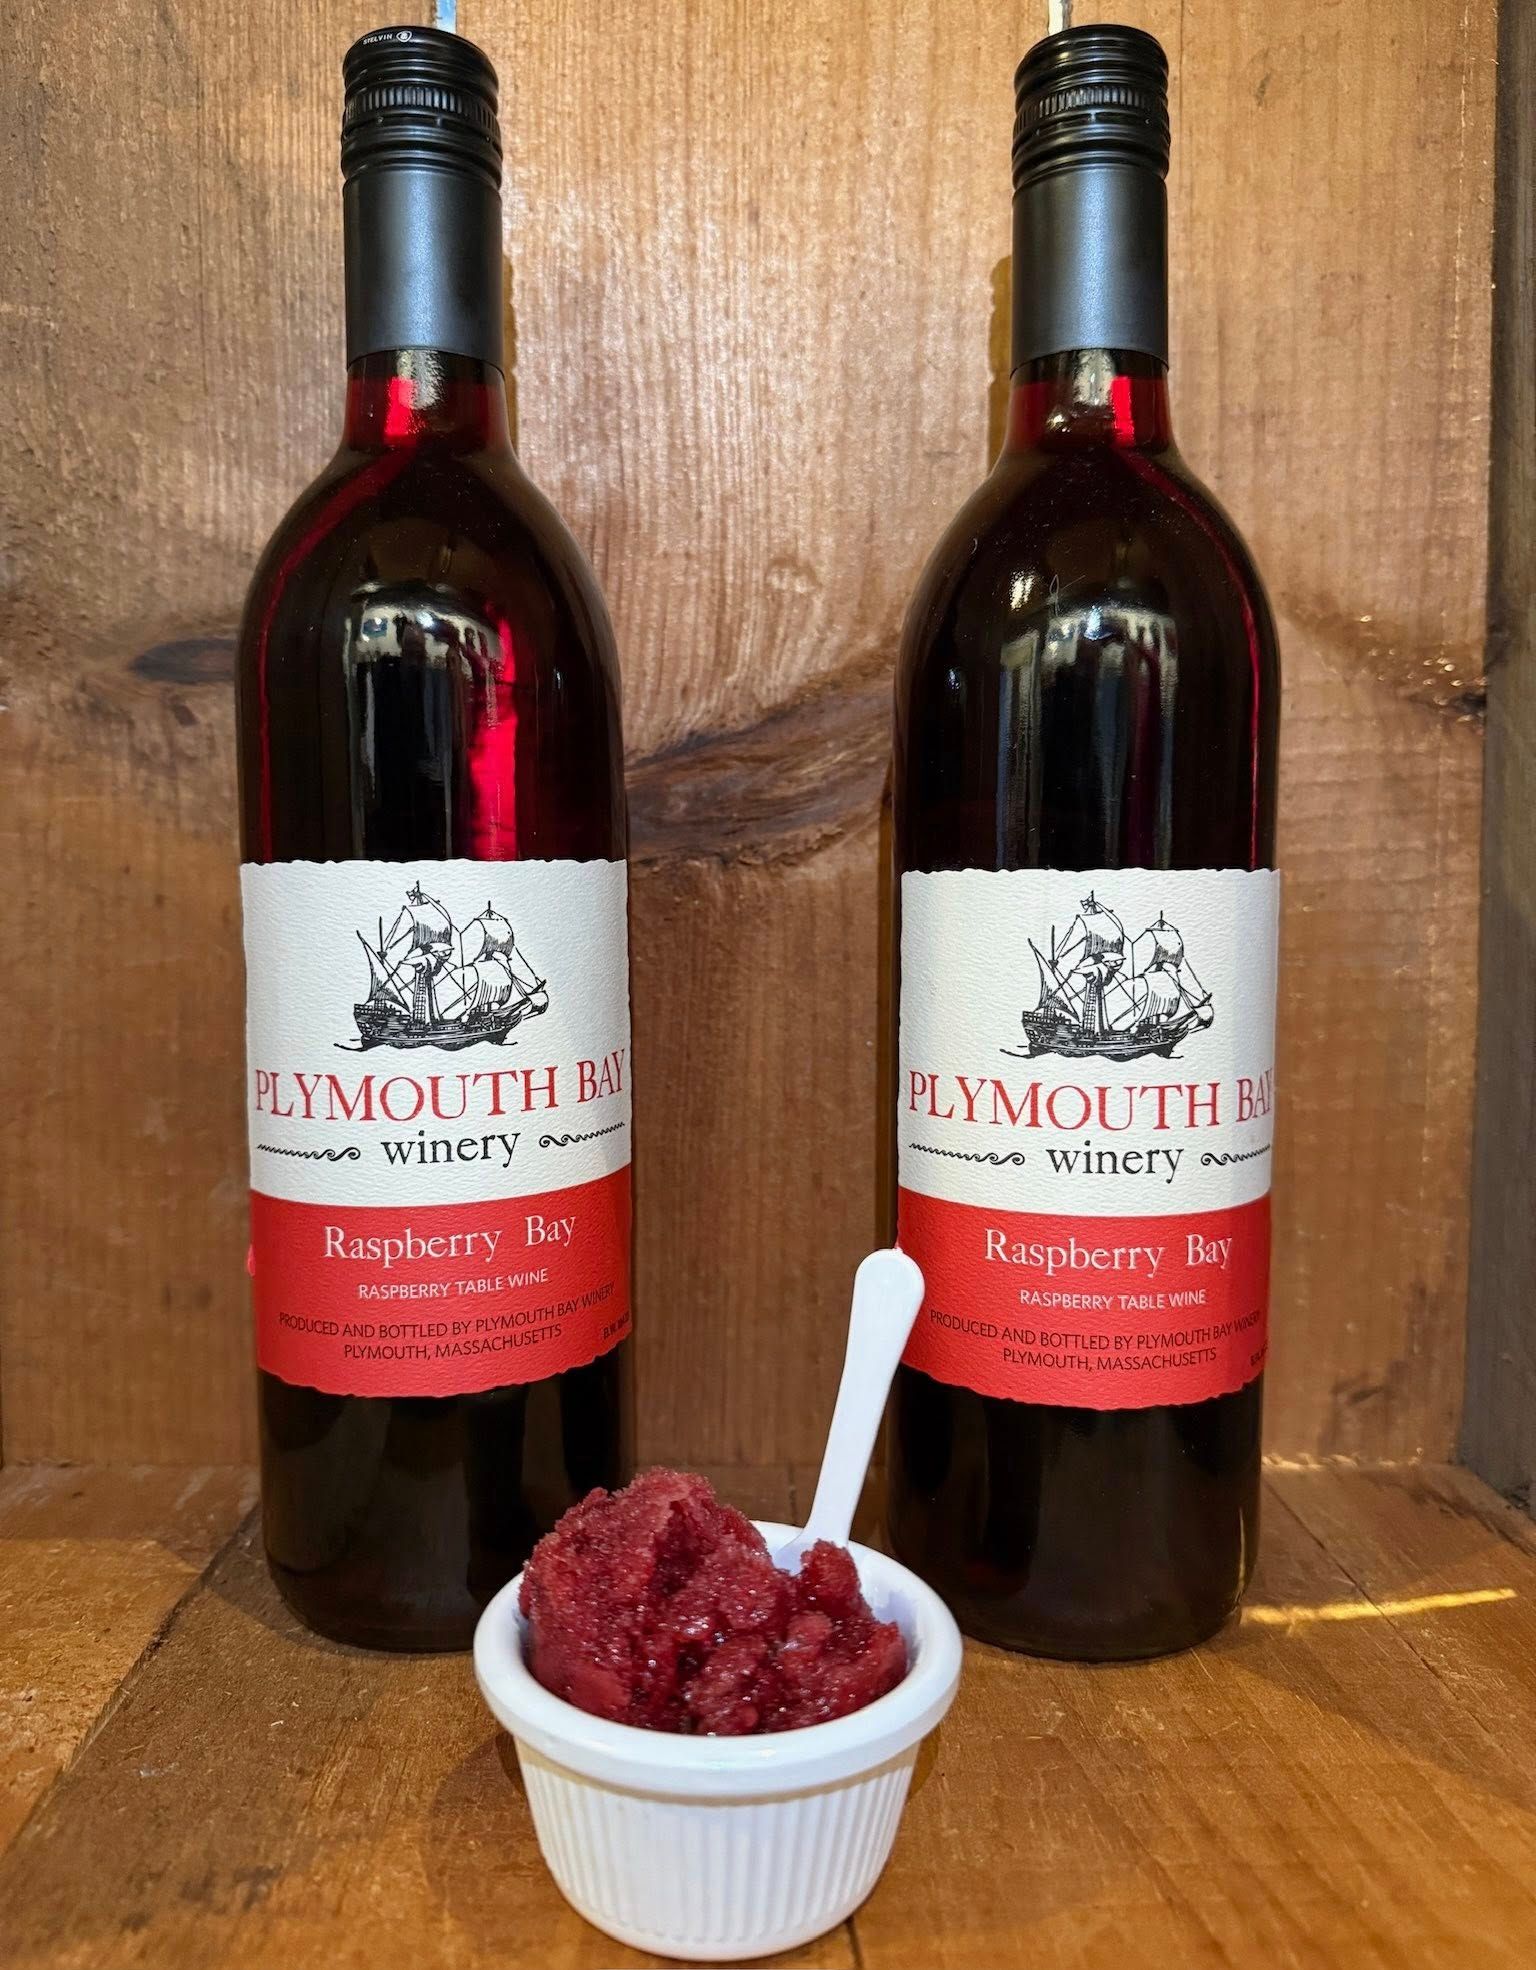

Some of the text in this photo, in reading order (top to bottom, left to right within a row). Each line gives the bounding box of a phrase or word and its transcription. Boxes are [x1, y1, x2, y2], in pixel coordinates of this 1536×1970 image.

[362, 33, 393, 45] STELVIN
[255, 1049, 625, 1121] PLYMOUTH BAY
[909, 1068, 1273, 1131] PLYMOUTH BAY
[381, 1130, 521, 1168] winery
[1046, 1140, 1184, 1184] winery
[323, 1214, 577, 1269] Raspberry Bay
[984, 1229, 1233, 1278] Raspberry Bay
[358, 1268, 549, 1300] RASPBERRY TABLE WINE
[1019, 1288, 1207, 1310] RASPBERRY TABLE WINE
[278, 1282, 616, 1339] PRODUCED AND BOTTLED BY PLYMOUTH BAY WINERY
[930, 1309, 999, 1339] PRODUCED
[1001, 1327, 1037, 1346] AND
[1040, 1331, 1110, 1350] BOTTLED
[1114, 1335, 1135, 1350] BY
[1137, 1327, 1212, 1350] PLYMOUTH
[1213, 1321, 1235, 1340] BAY
[344, 1323, 563, 1361] PLYMOUTH, MASSACHUSETTS
[1003, 1346, 1217, 1373] PLYMOUTH, MASSACHUSETTS
